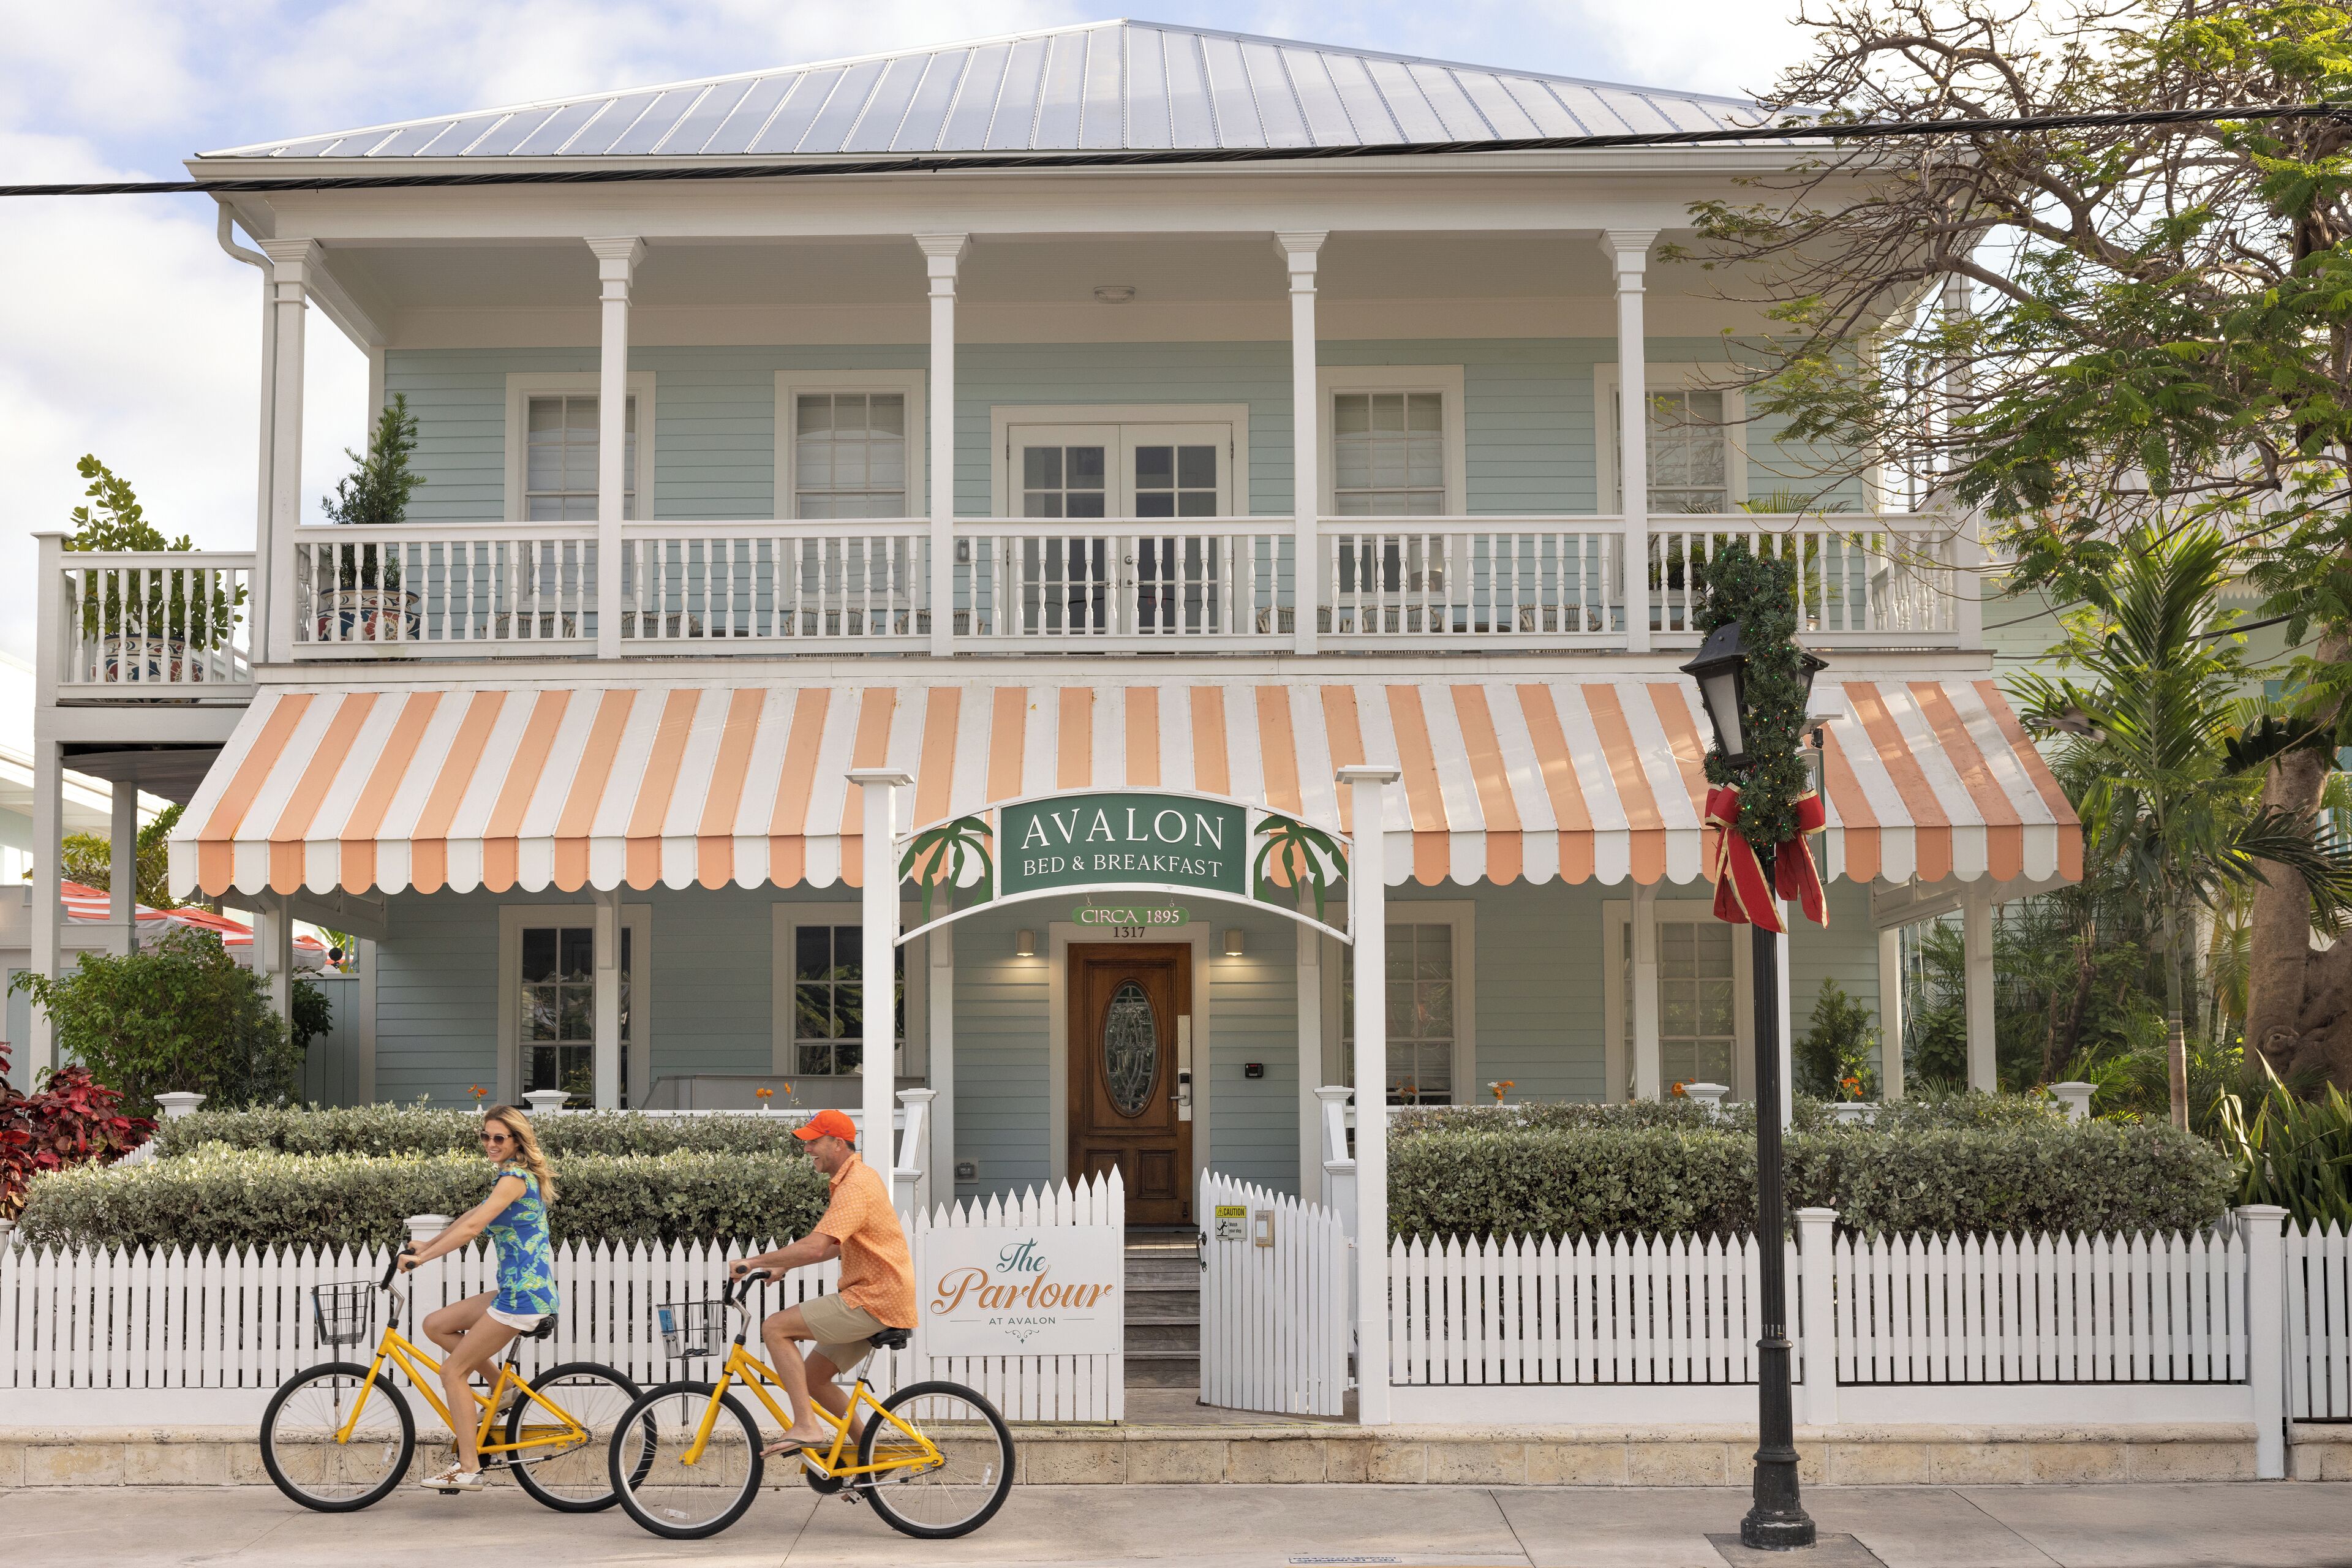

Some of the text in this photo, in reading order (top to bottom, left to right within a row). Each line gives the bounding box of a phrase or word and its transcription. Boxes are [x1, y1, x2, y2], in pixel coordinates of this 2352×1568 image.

[1020, 808, 1224, 850] AVALON
[1023, 854, 1223, 878] BED & BREAKFAST
[1081, 909, 1180, 924] CIRCA 1895
[1113, 926, 1145, 938] 1317
[996, 1237, 1046, 1273] The
[930, 1264, 1115, 1316] Parlour
